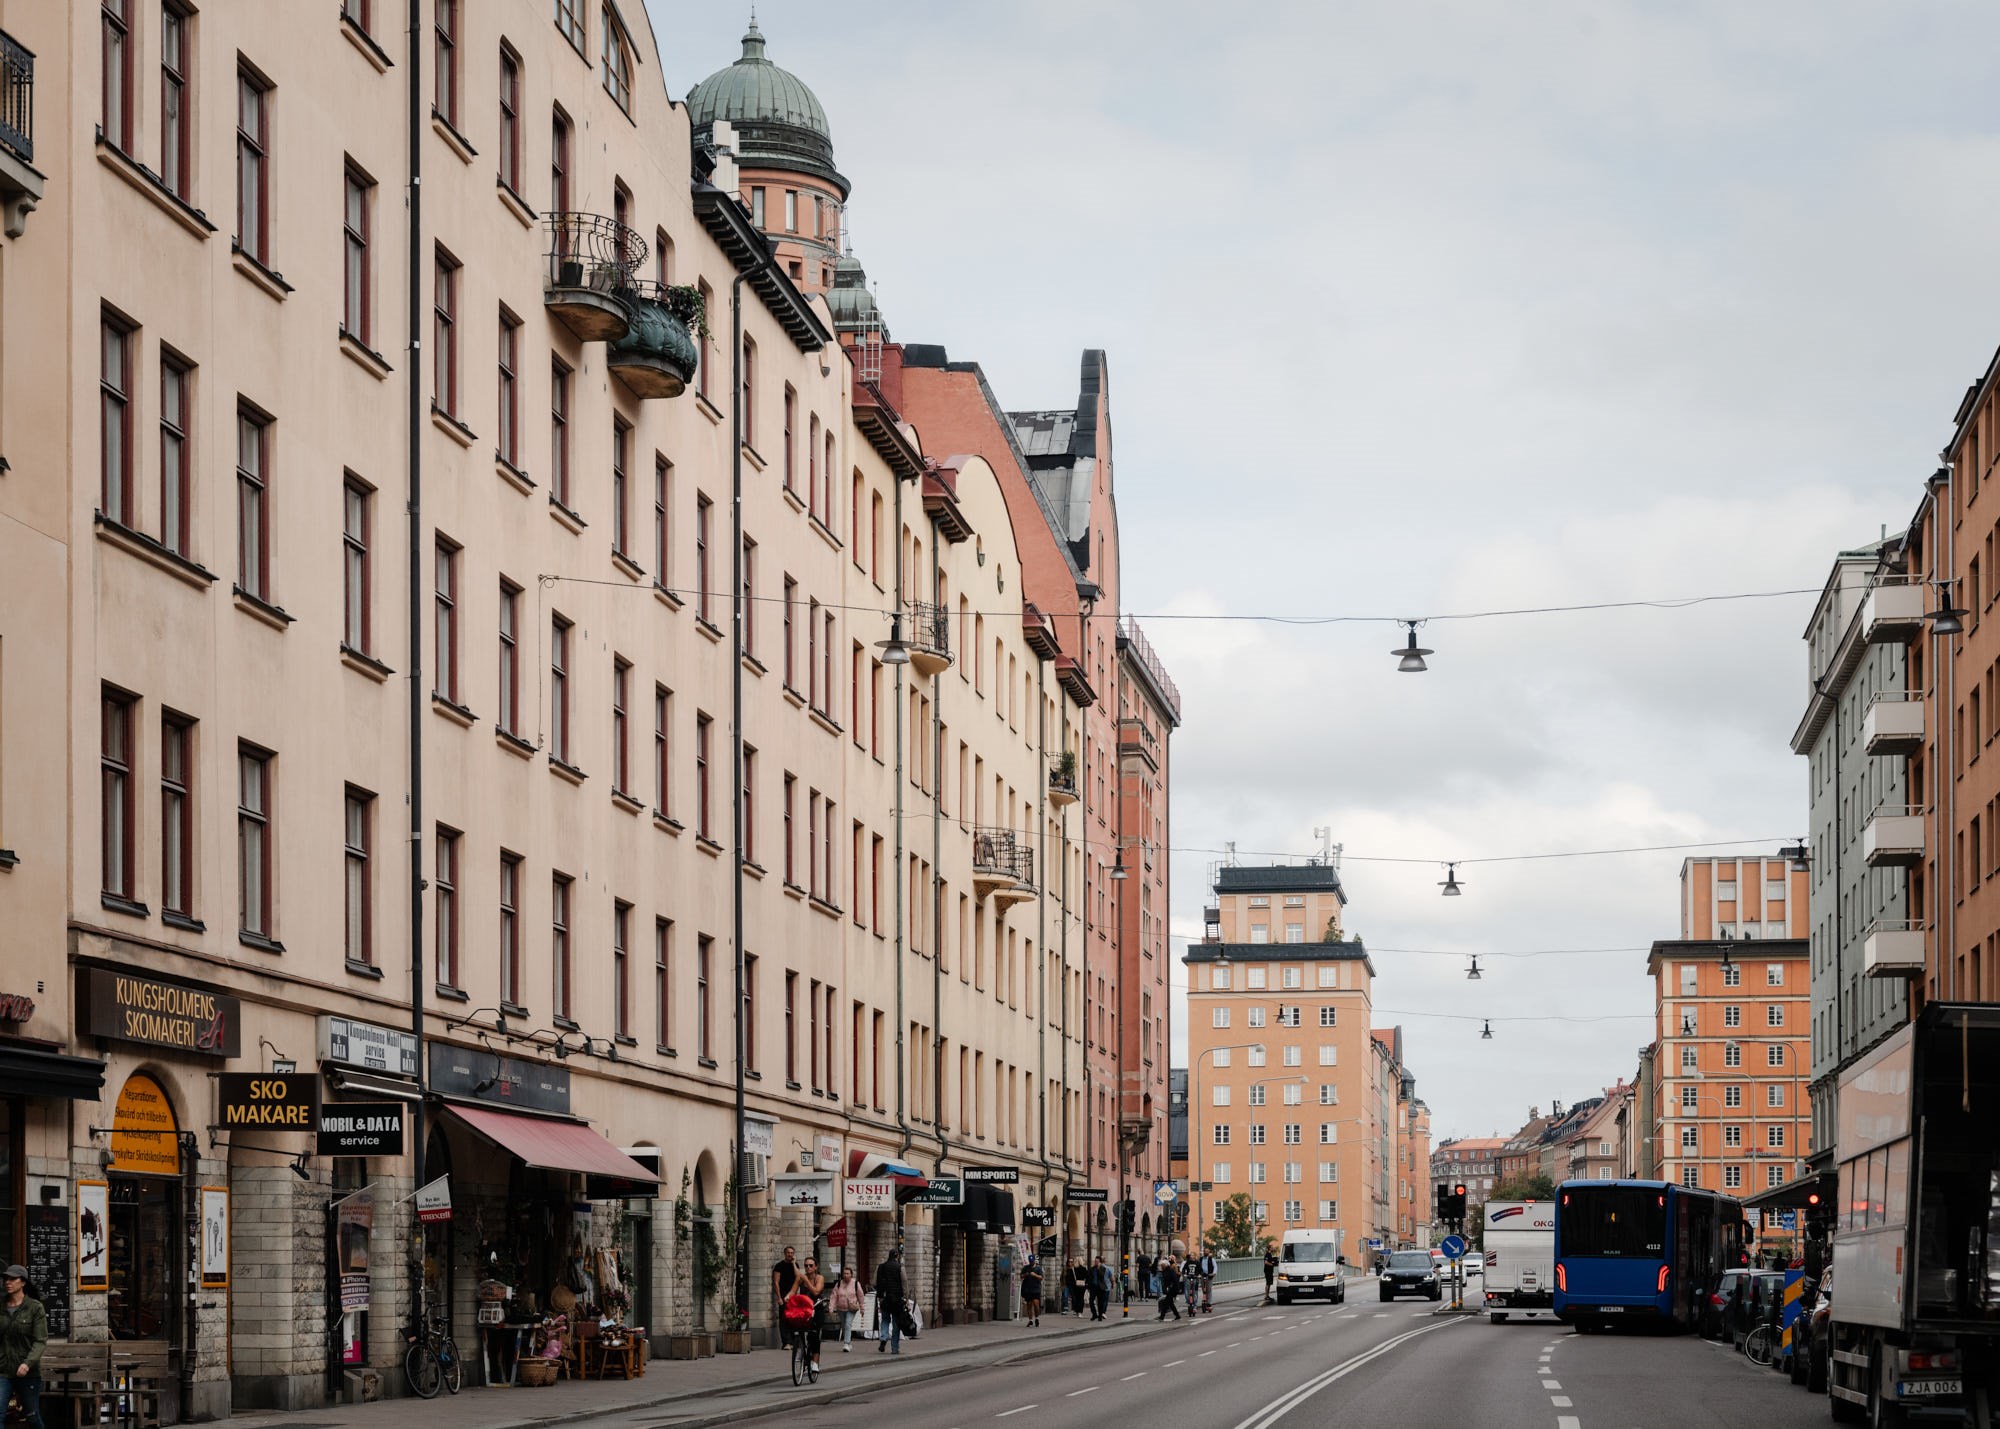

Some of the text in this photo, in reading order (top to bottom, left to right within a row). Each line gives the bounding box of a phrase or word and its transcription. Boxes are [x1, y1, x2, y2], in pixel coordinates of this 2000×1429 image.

[116, 977, 216, 1021] KUNGSHOLMENS
[125, 1010, 195, 1047] SKOMAKERI
[250, 1080, 287, 1100] SKO
[125, 1088, 158, 1104] Reparationer
[227, 1105, 309, 1124] MAKARE
[340, 1136, 380, 1146] service
[802, 1154, 813, 1164] 57
[965, 1171, 1017, 1180] MM SPORTS
[847, 1184, 890, 1195] SUSHI
[928, 1180, 952, 1193] Eriks
[929, 1194, 955, 1204] Massage
[421, 1210, 451, 1221] maxell
[1026, 1208, 1048, 1218] Klipp
[1043, 1217, 1052, 1226] 61
[341, 1286, 368, 1295] SAMSUNG
[342, 1296, 367, 1306] SONY
[1908, 1382, 1957, 1394] ZJA 006
